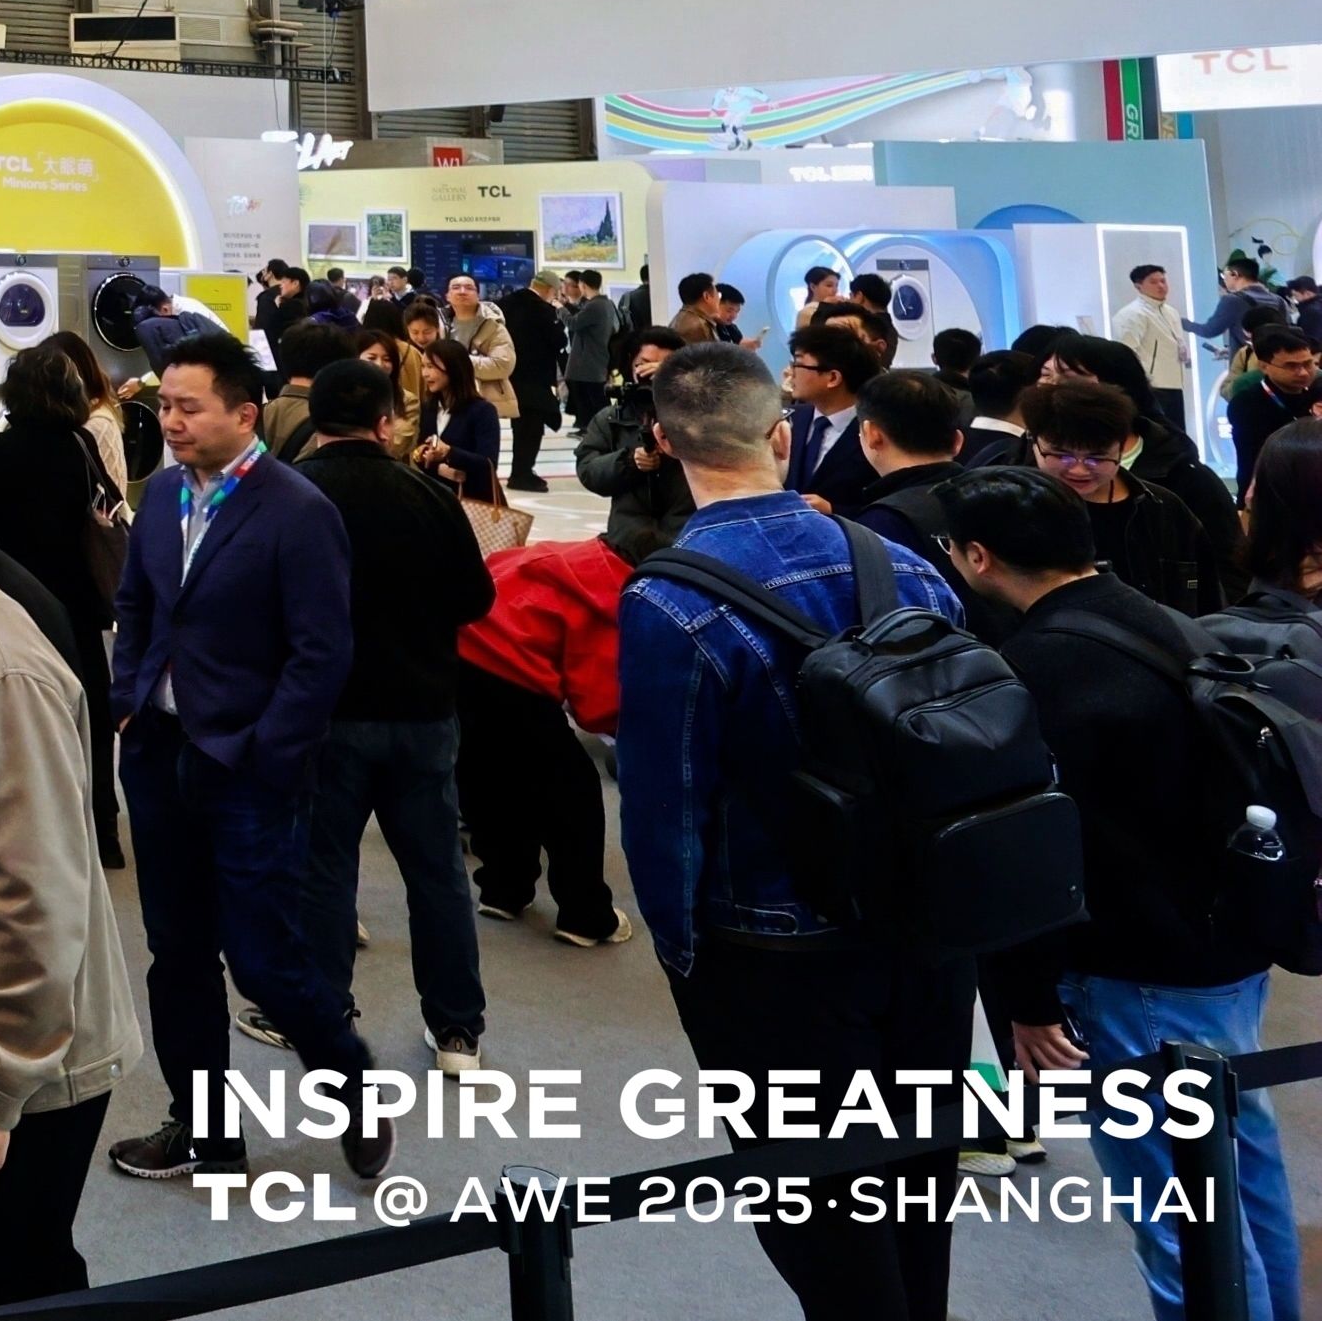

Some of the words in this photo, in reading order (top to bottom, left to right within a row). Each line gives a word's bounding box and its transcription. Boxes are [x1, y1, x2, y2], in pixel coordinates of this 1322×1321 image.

[1192, 47, 1288, 75] TCL
[2, 176, 47, 191] Minions
[51, 179, 88, 192] Series
[478, 185, 512, 198] TCL
